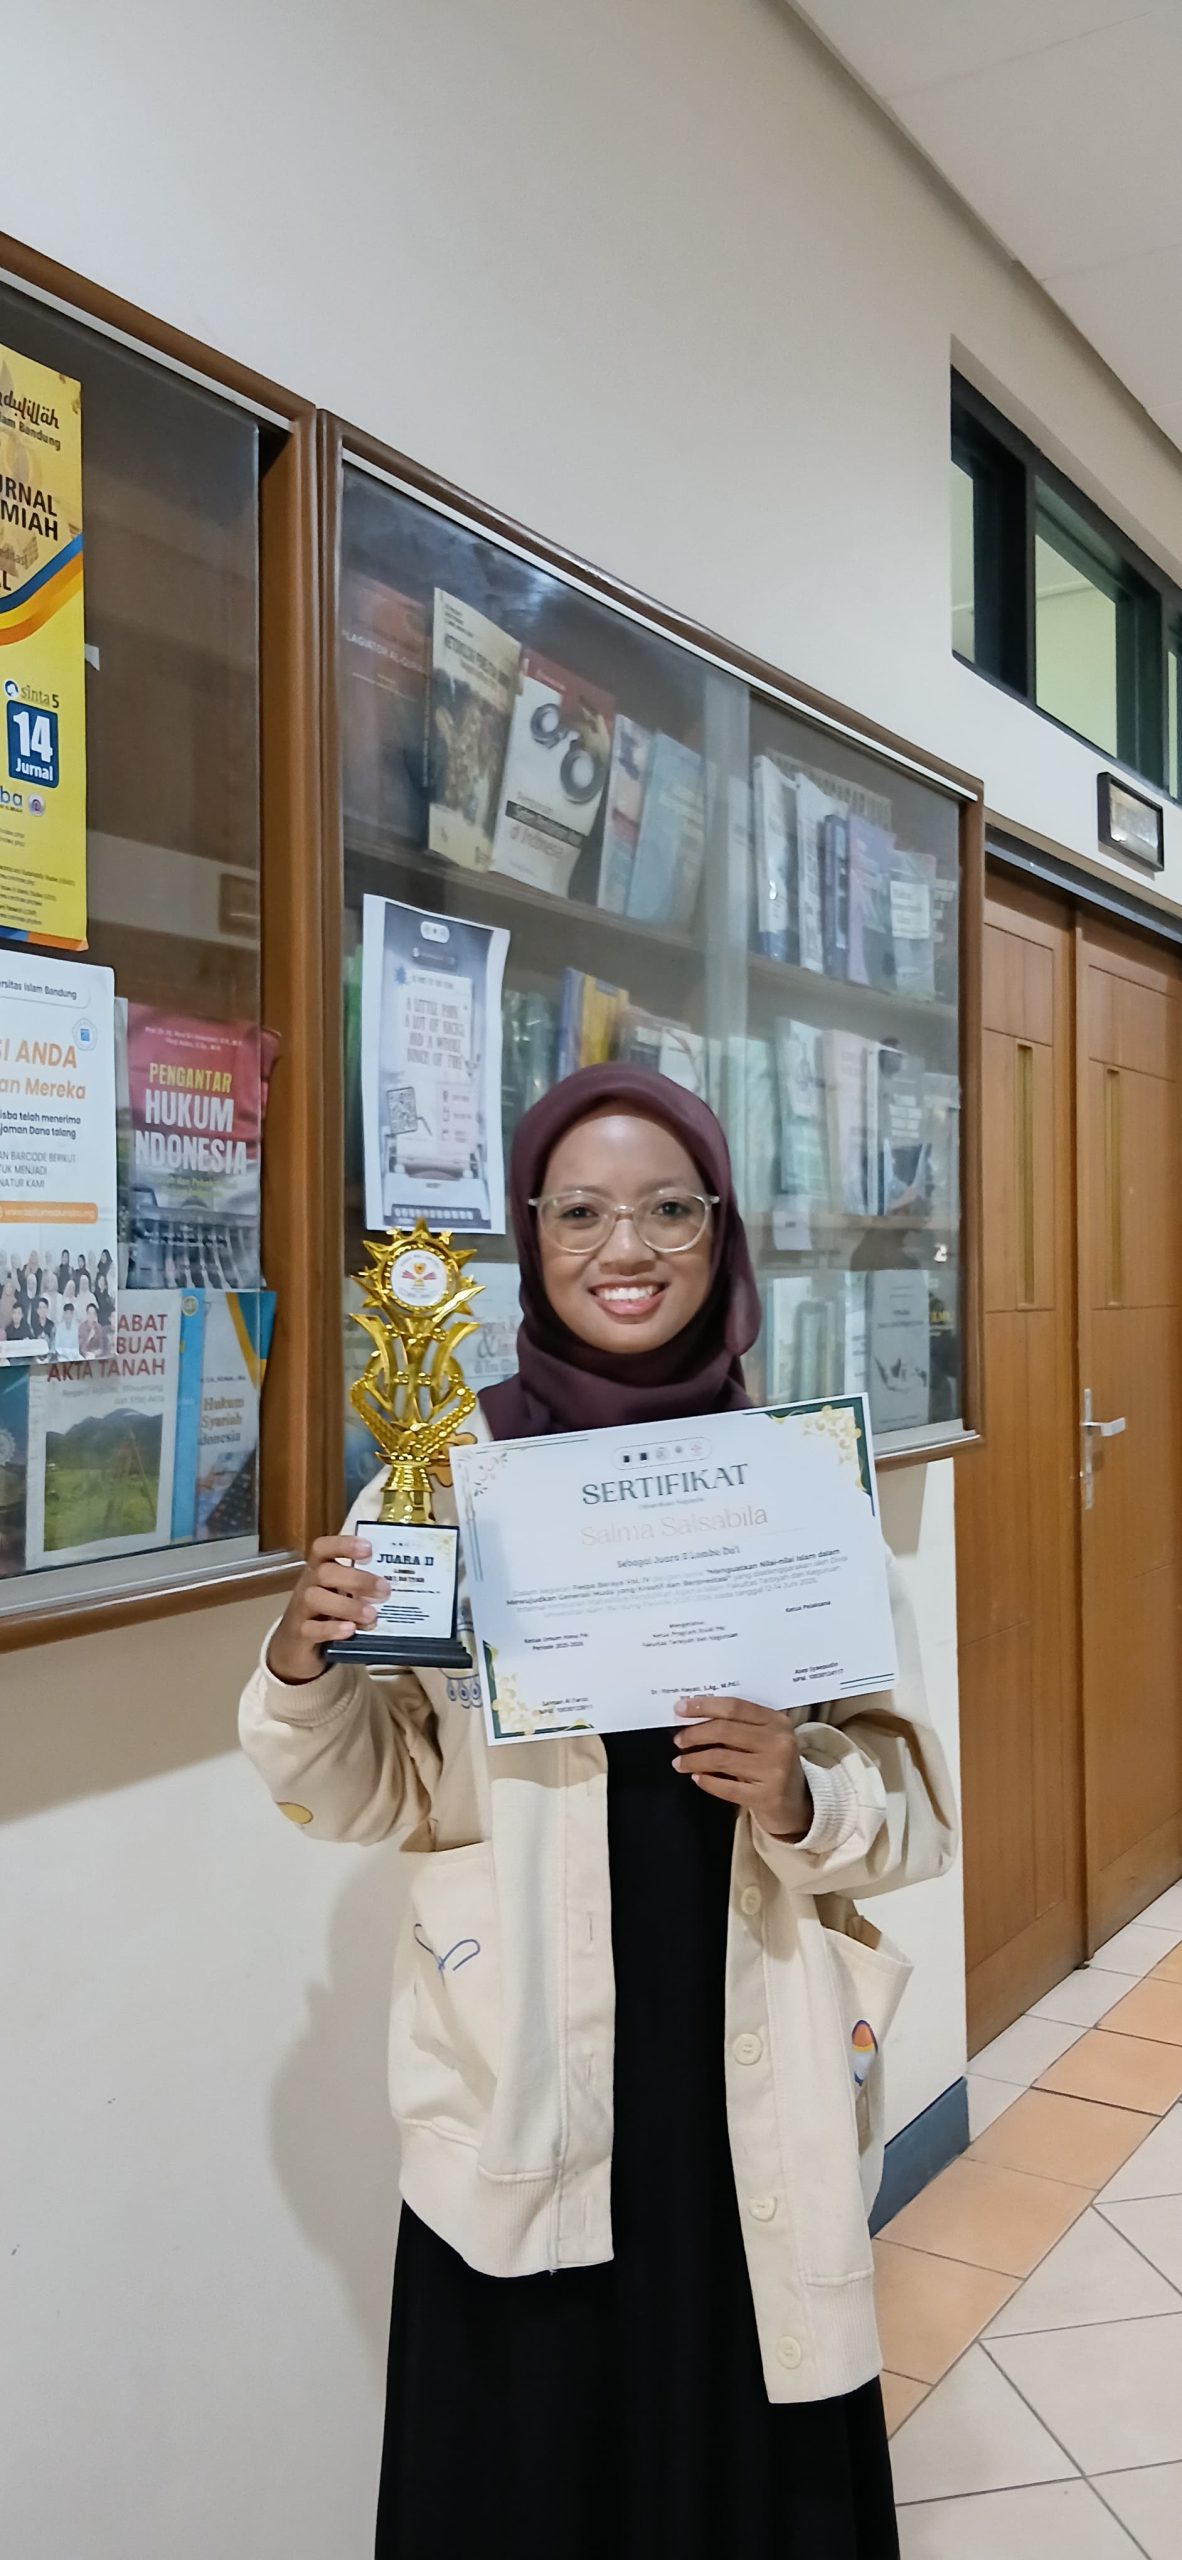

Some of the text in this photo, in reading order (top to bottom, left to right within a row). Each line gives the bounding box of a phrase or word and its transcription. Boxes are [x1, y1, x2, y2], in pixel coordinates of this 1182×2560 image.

[18, 420, 61, 452] Bandung
[21, 684, 60, 709] sinta 5
[13, 711, 54, 763] 14
[16, 757, 54, 781] Jurnal
[23, 982, 43, 994] Islam
[44, 985, 77, 1001] Bandung
[15, 1039, 77, 1069] ANDA
[25, 1077, 86, 1100] Mereka
[148, 1062, 233, 1094] PENGANTAR
[19, 1111, 41, 1122] telah
[42, 1113, 82, 1125] menerima
[145, 1088, 235, 1134] HUKUM
[29, 1125, 51, 1136] Dana
[51, 1127, 77, 1140] talang
[10, 1151, 48, 1162] BARCODE
[134, 1130, 248, 1176] NDONESIA
[14, 1164, 48, 1175] MENJADI
[25, 1179, 46, 1188] KAMI
[46, 1358, 166, 1383] AKTA TANAH
[203, 1396, 245, 1412] Hukum
[201, 1412, 242, 1431] Syariah
[581, 1463, 749, 1505] SERTIFIKAT
[579, 1504, 768, 1546] Salma Salsabila
[376, 1553, 420, 1566] JUARA
